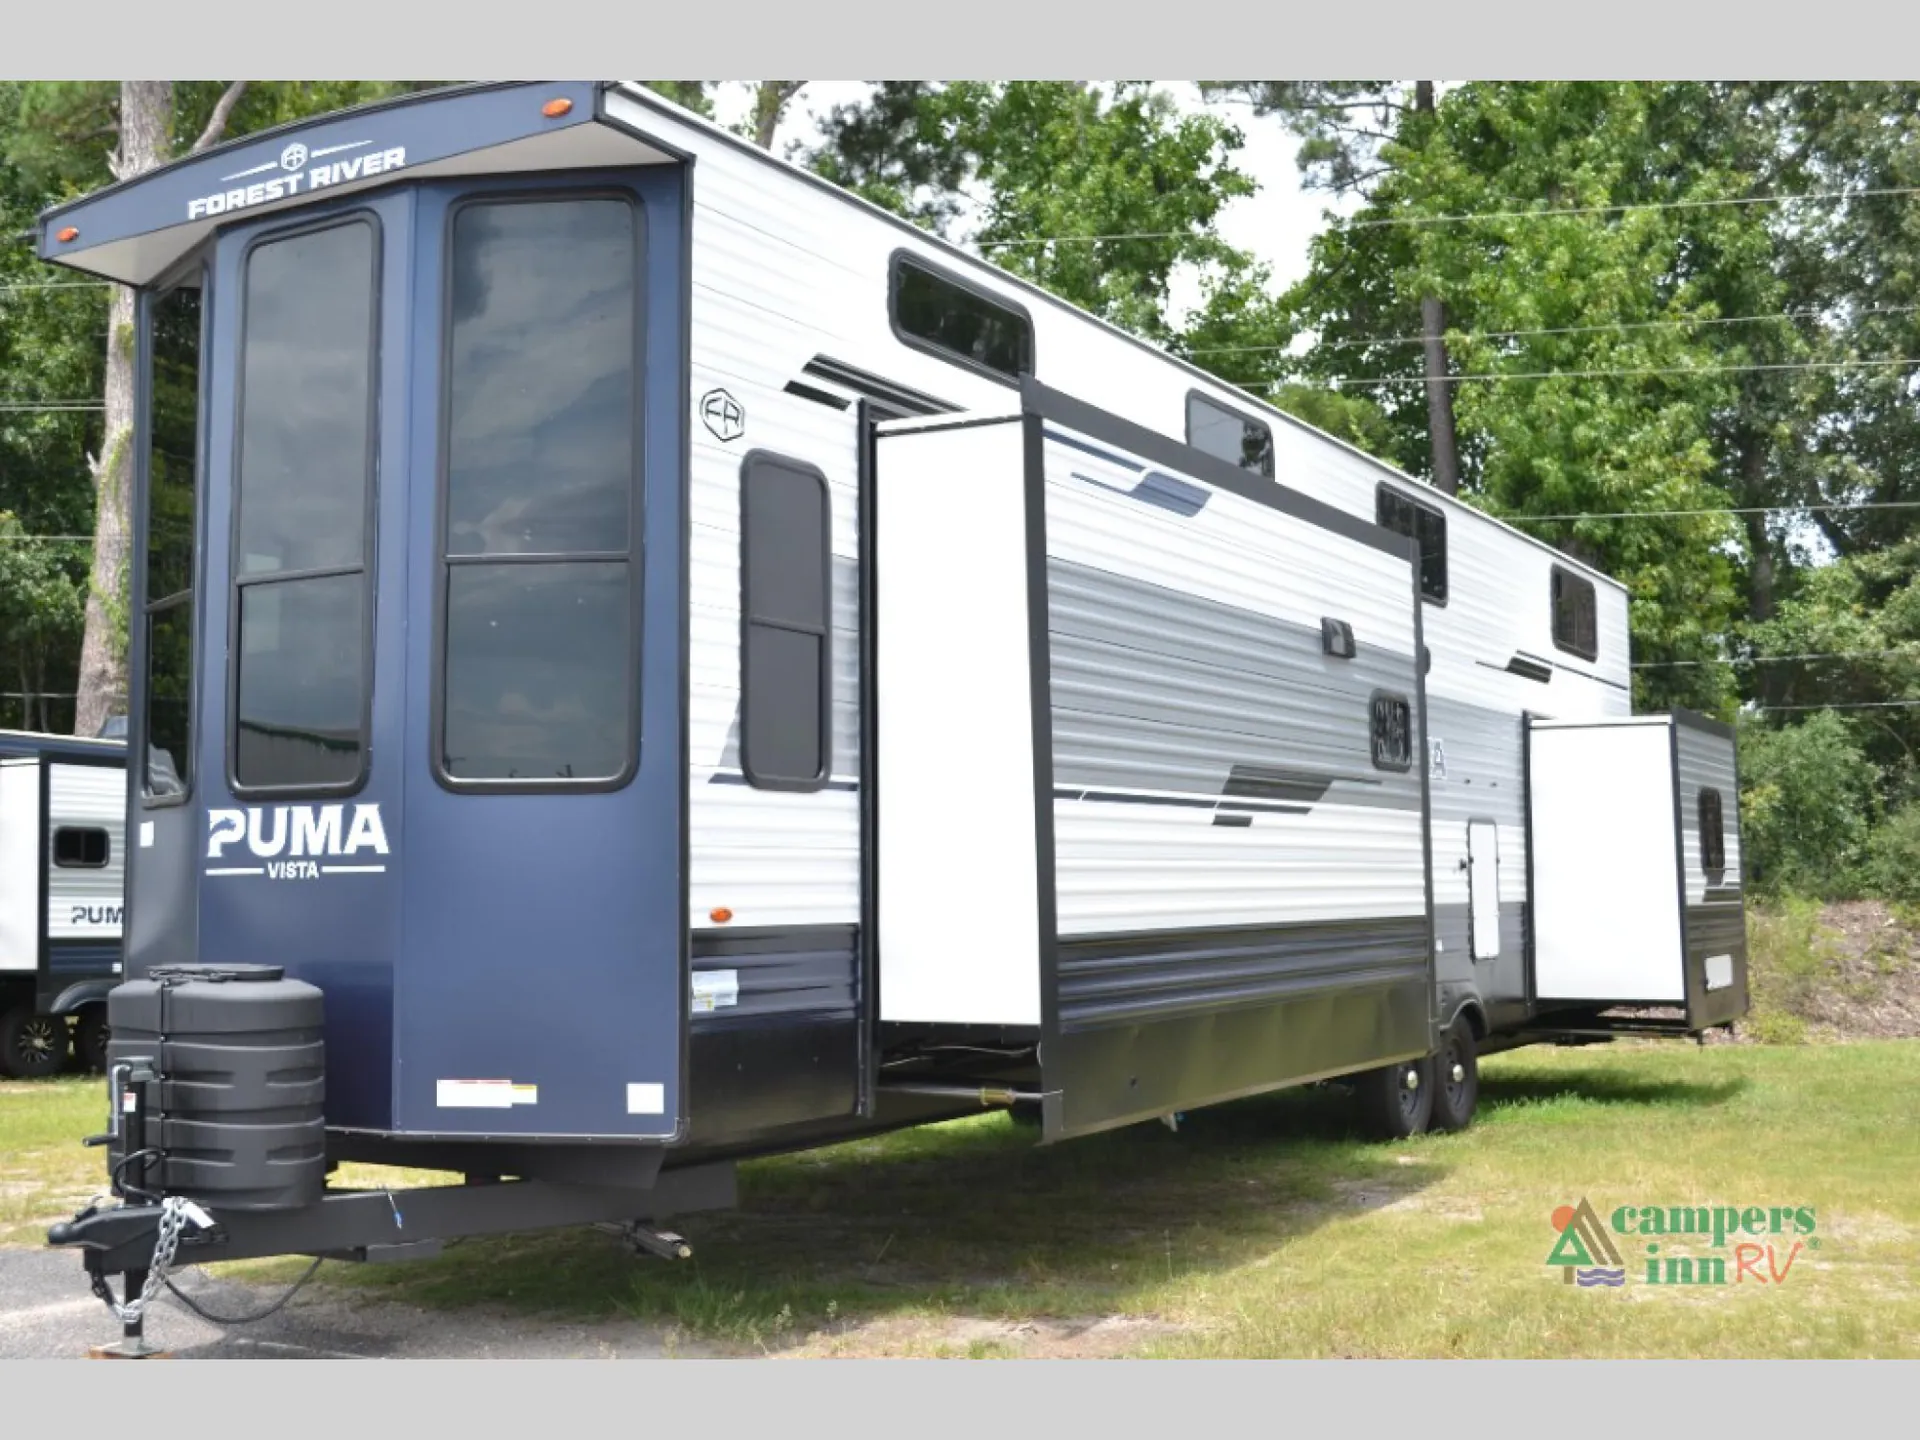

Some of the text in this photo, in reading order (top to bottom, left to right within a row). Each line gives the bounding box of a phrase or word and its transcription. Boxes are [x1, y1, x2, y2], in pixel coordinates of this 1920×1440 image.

[188, 172, 304, 220] FOREST
[310, 146, 406, 189] RIVER
[207, 804, 389, 857] PUMA
[267, 860, 320, 879] VISTA
